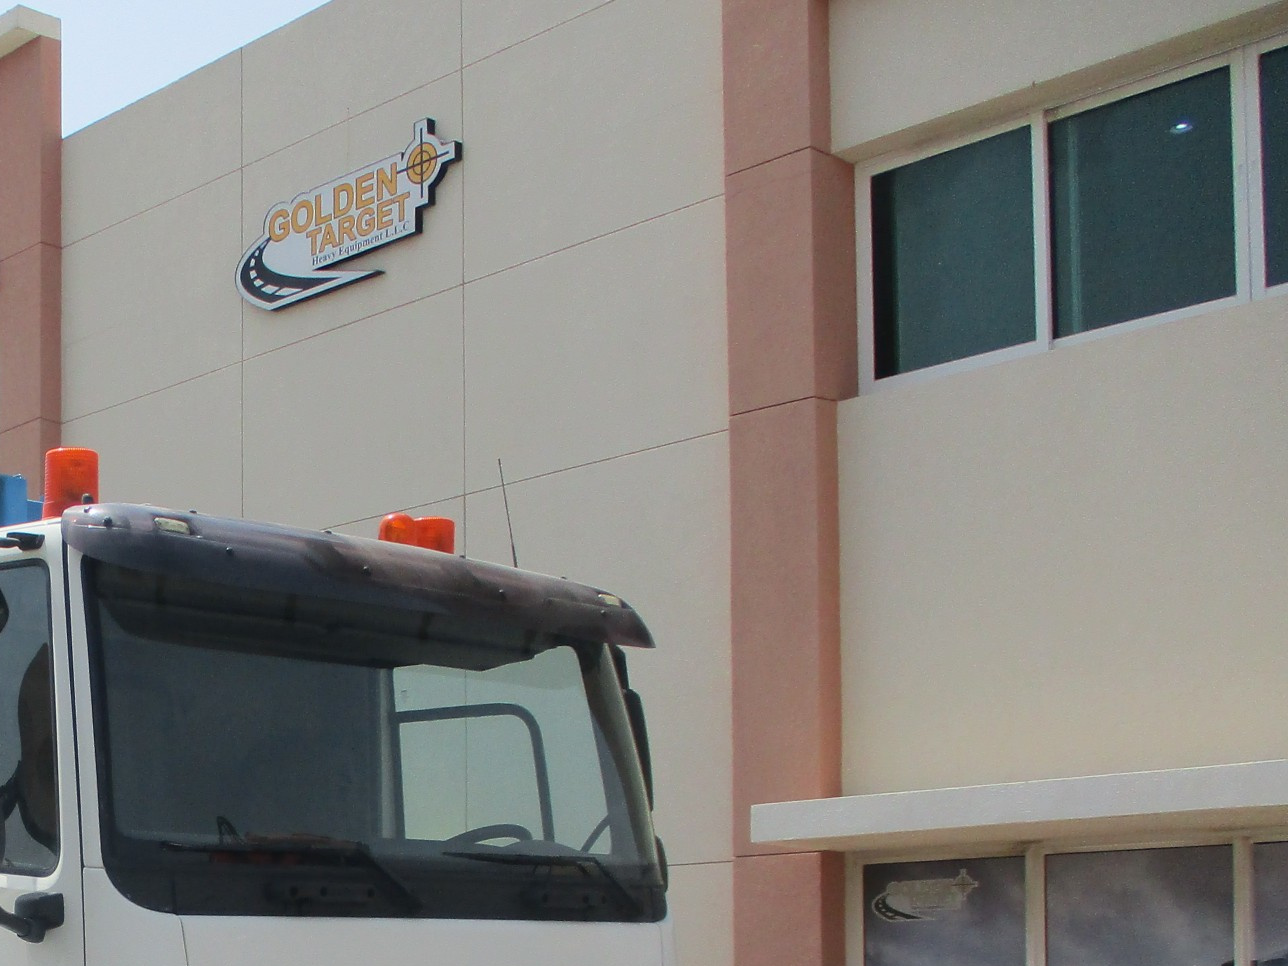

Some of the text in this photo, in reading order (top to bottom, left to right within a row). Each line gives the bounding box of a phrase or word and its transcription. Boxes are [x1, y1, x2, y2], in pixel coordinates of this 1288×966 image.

[268, 162, 398, 242] GOLDEN
[306, 192, 410, 256] TARGET
[312, 250, 337, 266] Heavy
[339, 232, 383, 256] Equipment
